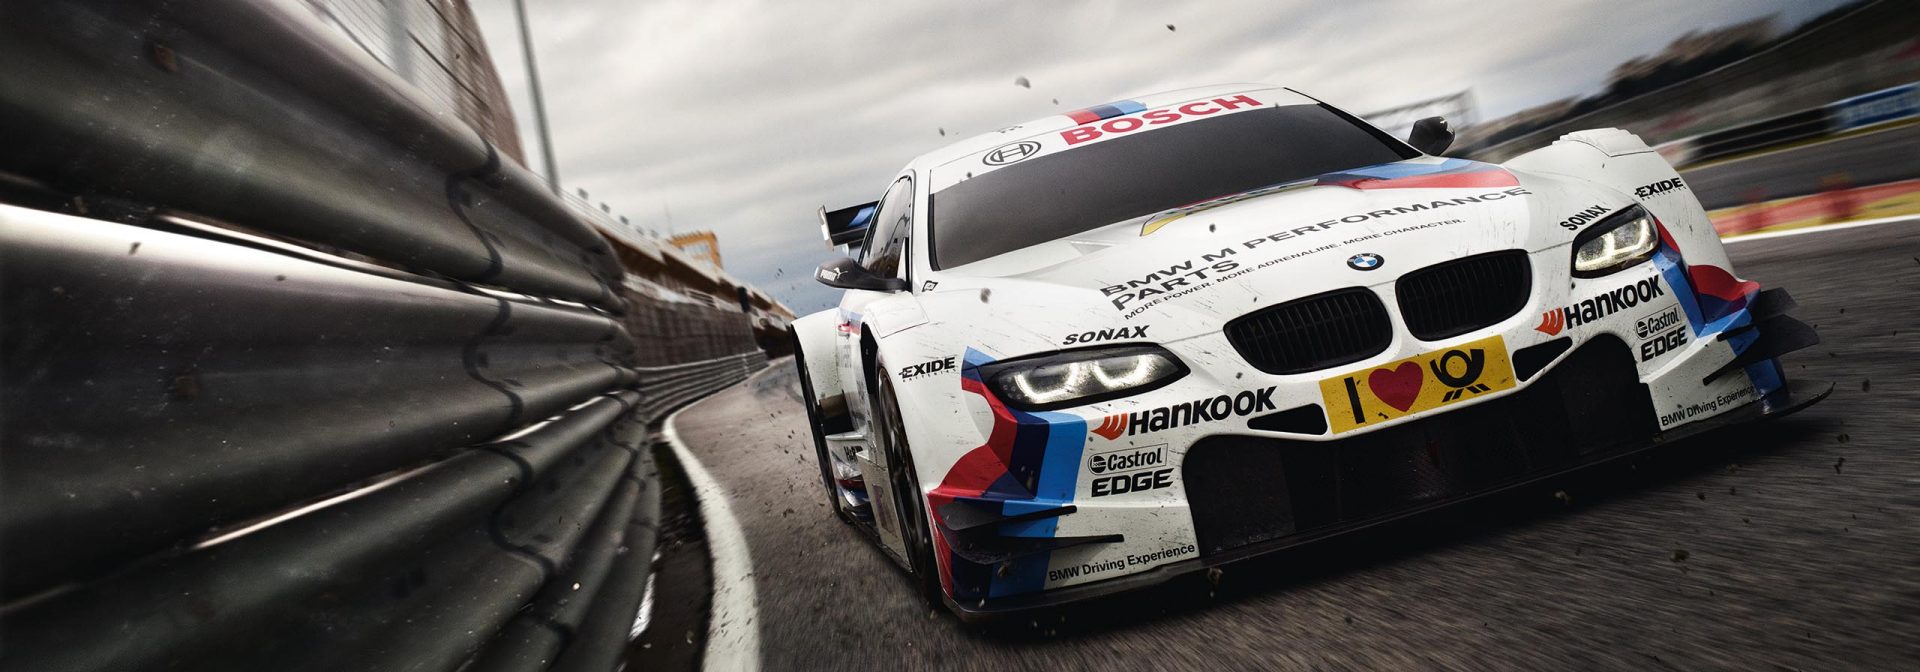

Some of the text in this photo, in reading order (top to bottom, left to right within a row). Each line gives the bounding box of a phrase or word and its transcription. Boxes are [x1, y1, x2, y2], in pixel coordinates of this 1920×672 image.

[1060, 94, 1263, 145] BOSCH
[1634, 177, 1684, 198] EXIDE
[1560, 204, 1612, 231] SONAX
[1100, 186, 1533, 297] BMW M PERFORMANCE
[1111, 260, 1240, 311] PARTS
[1124, 218, 1466, 320] MORE POWER. MORE ADRENALINE. MORE CHARACTER.
[1062, 325, 1150, 345] SONAX
[1647, 307, 1680, 334] Castrol
[1640, 325, 1688, 362] EDGE
[899, 357, 955, 378] EXIDE
[1344, 376, 1366, 424] I
[1660, 385, 1755, 426] BMW Driving Experience
[1107, 447, 1162, 471] Castrol
[1091, 468, 1175, 497] EDGE
[1048, 544, 1195, 581] BMW Driving Experience
